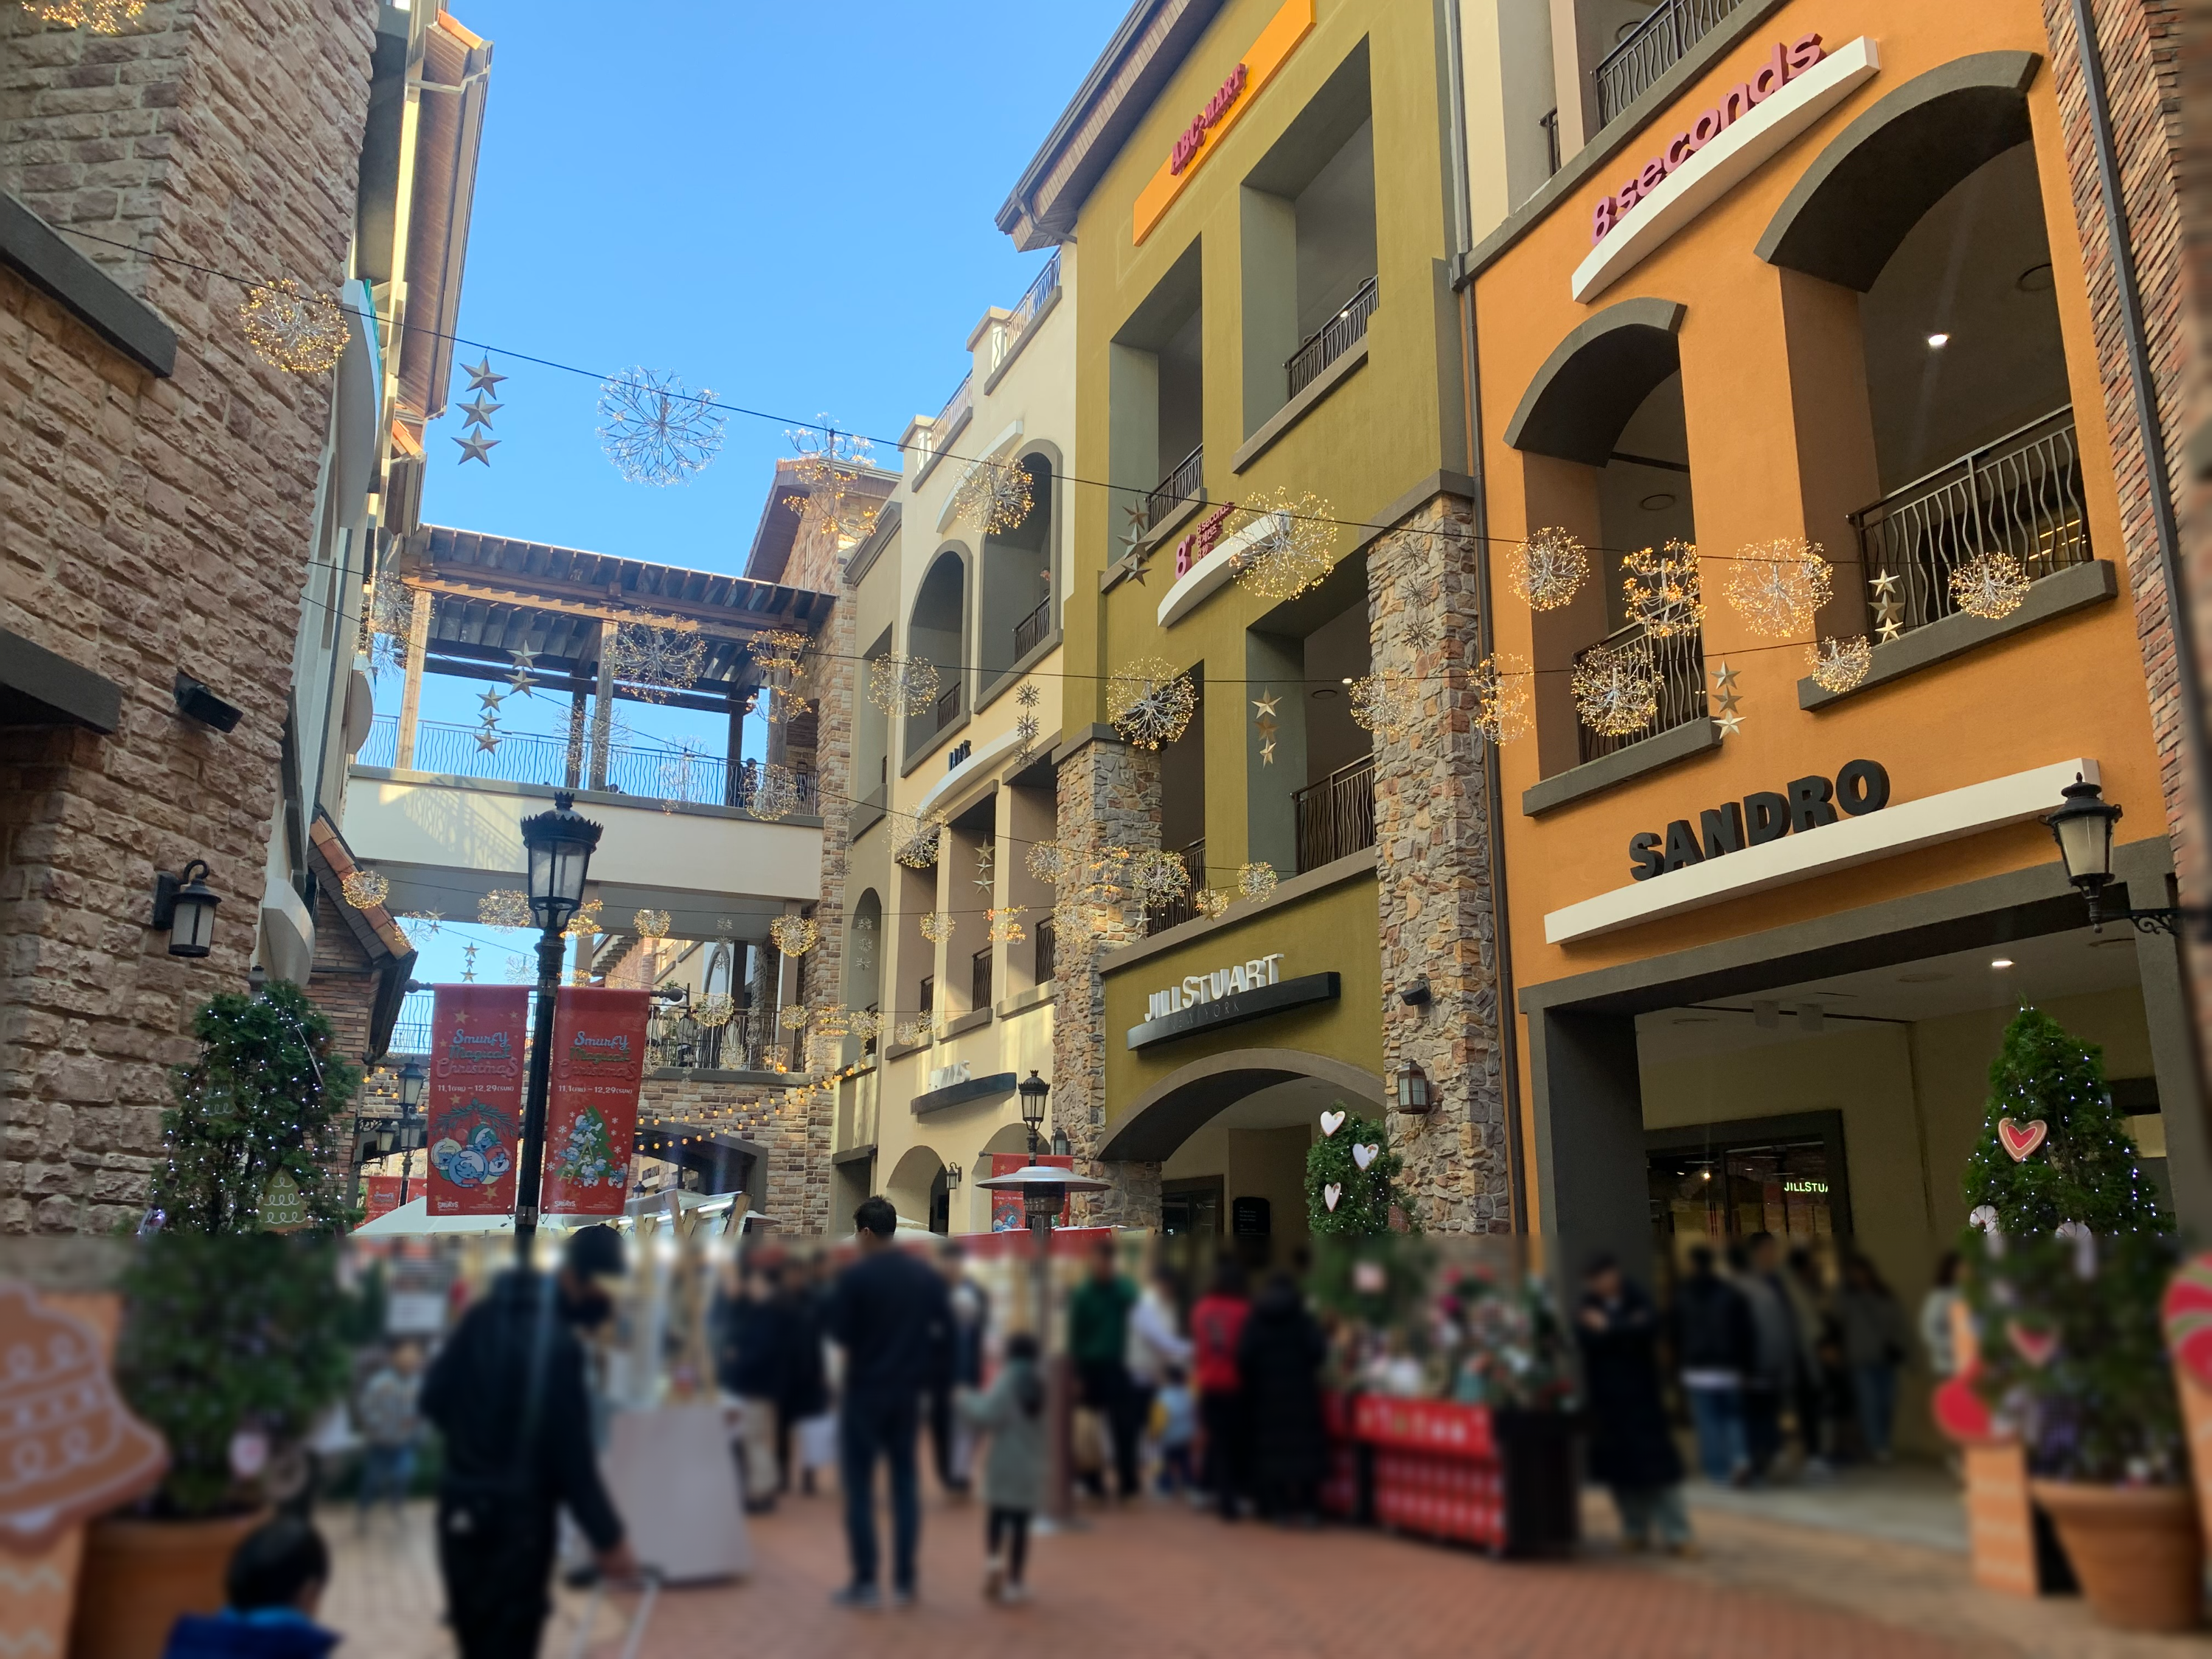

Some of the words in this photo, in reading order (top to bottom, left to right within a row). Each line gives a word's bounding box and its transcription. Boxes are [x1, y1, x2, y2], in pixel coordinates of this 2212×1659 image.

[1171, 63, 1246, 175] ABC-MART
[1629, 759, 1890, 882] SANDRO
[1204, 1001, 1239, 1020] YORK
